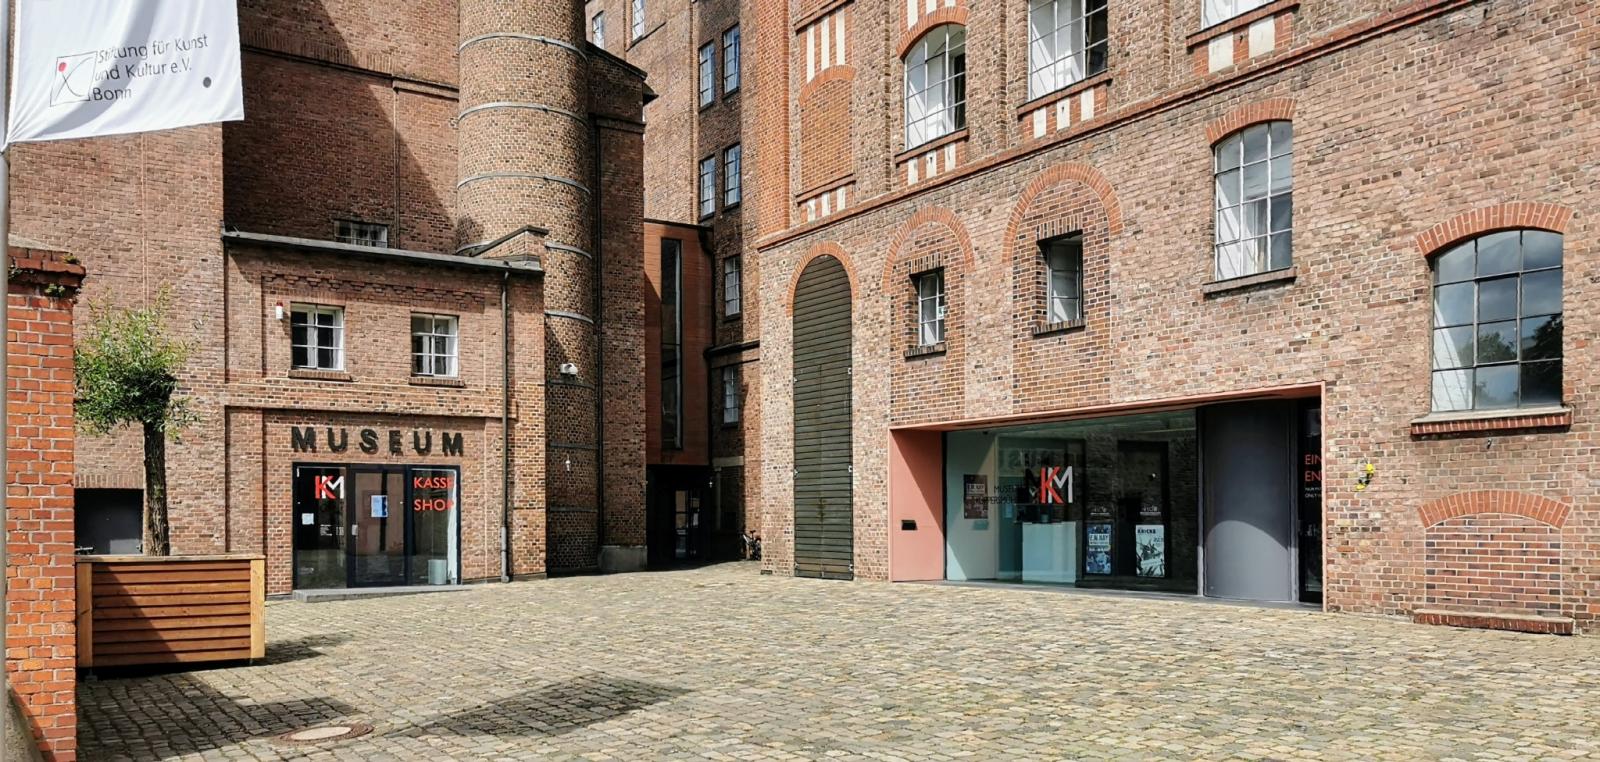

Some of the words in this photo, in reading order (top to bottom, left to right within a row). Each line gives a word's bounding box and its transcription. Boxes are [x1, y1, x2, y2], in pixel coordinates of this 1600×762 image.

[98, 44, 147, 64] Stiftung
[152, 41, 169, 56] für
[175, 34, 208, 52] Kunst
[95, 65, 120, 82] und
[125, 63, 167, 79] Kultur
[170, 58, 192, 74] e.V.
[92, 87, 132, 102] Bonn
[291, 426, 464, 457] MUSEUM
